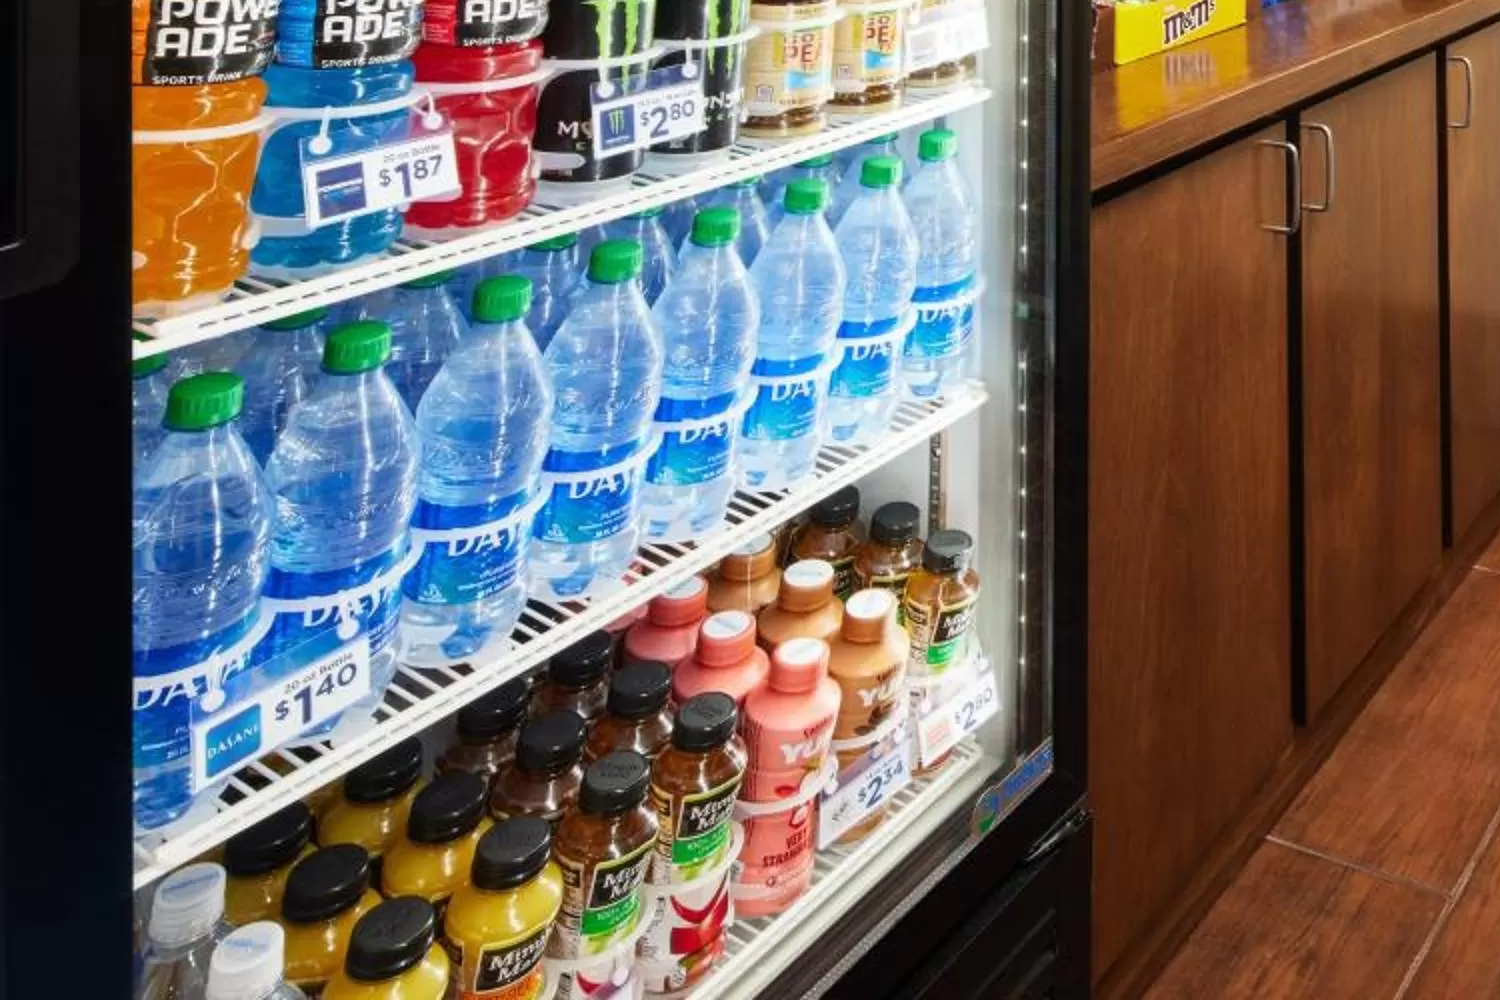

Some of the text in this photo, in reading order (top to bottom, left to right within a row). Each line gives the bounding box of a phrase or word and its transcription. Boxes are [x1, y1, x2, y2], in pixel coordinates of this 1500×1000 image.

[155, 24, 252, 58] ADE
[323, 10, 405, 44] ADE
[152, 75, 205, 85] SPORTS
[640, 100, 695, 138] $280
[378, 154, 443, 198] $187
[274, 662, 358, 724] $140
